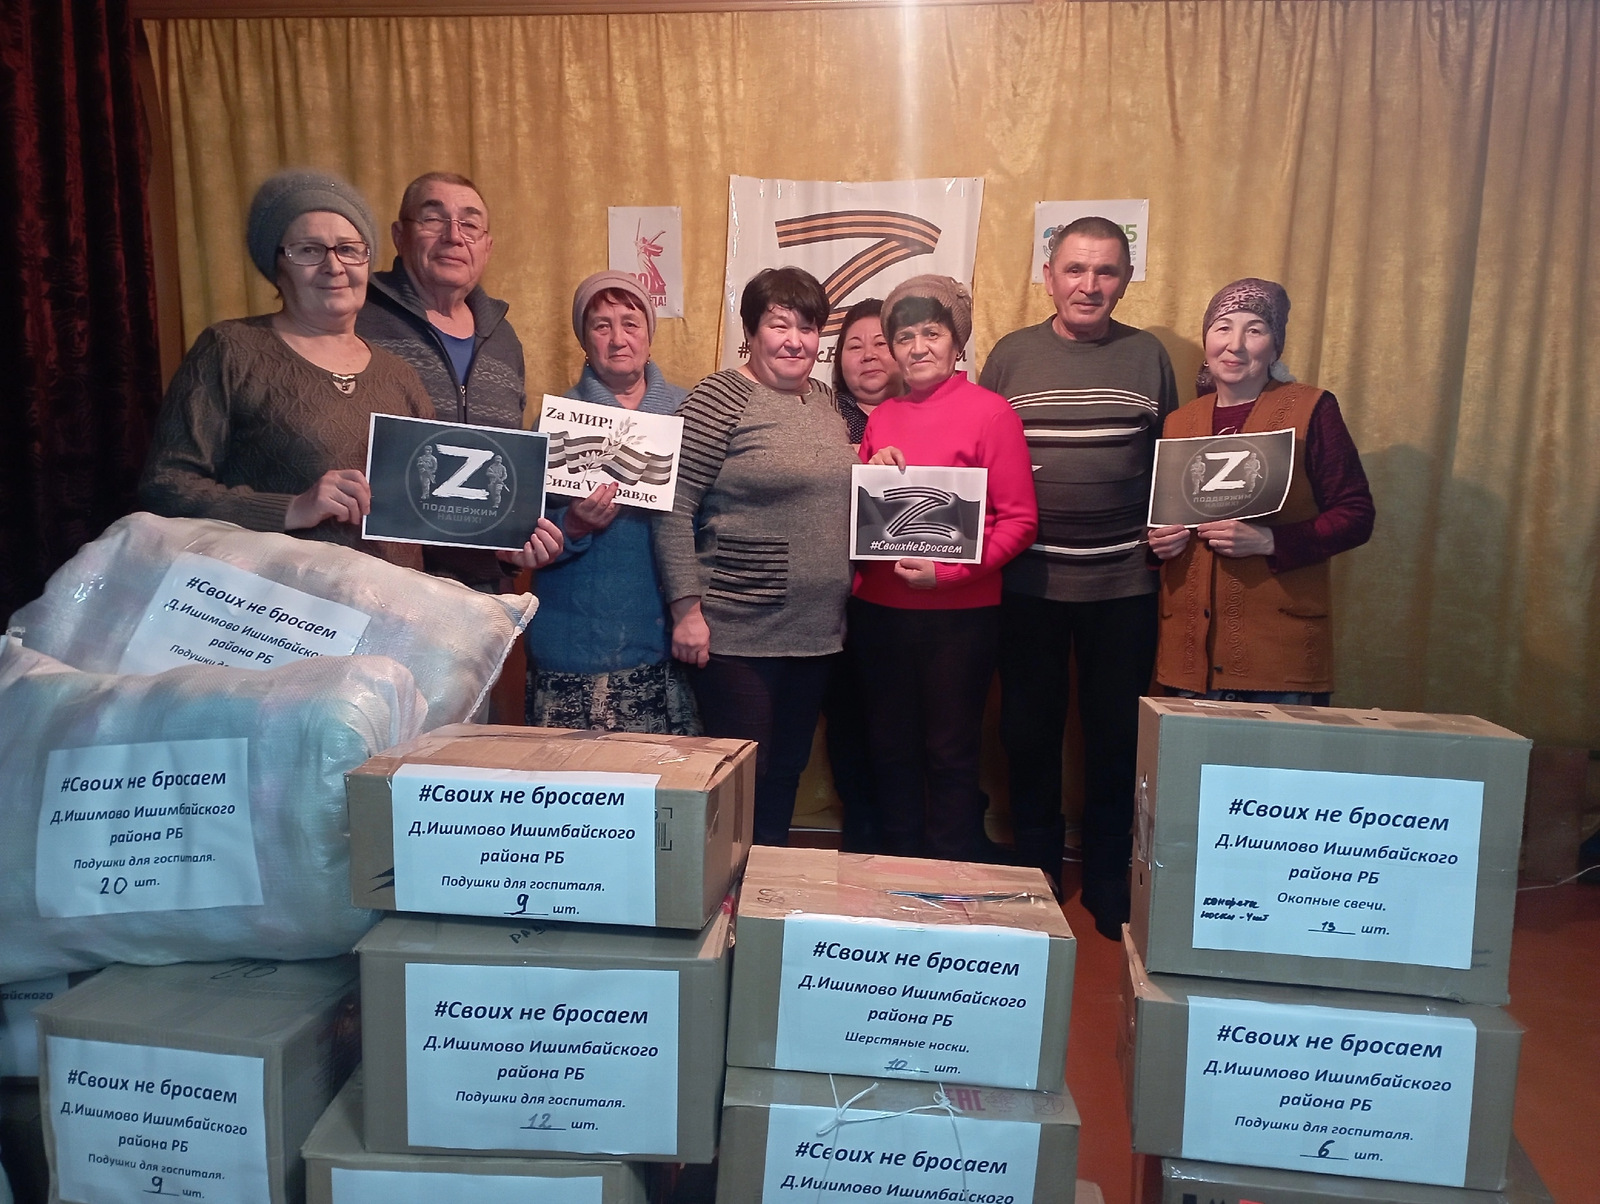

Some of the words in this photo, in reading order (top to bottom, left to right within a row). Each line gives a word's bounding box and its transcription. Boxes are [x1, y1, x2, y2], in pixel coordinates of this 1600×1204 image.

[569, 411, 614, 430] МИР!
[432, 443, 494, 501] Z
[1200, 451, 1250, 491] Z
[612, 488, 657, 503] равде
[1193, 494, 1251, 503] ПОДДЕРЖИМ
[422, 503, 497, 516] ПОДДЕРЖИМ
[438, 513, 481, 523] НАШИХ!
[870, 540, 962, 553] #СвоихНеБросаем
[186, 576, 246, 608] #Своих
[249, 602, 265, 616] не
[269, 607, 338, 640] бросаем
[164, 598, 240, 632] Д.Ишимово
[241, 627, 323, 657] Ишимбайско
[209, 637, 254, 658] района
[255, 652, 274, 665] РБ
[61, 776, 124, 793] #Своих
[127, 776, 146, 789] не
[152, 770, 226, 790] бросаем
[418, 784, 494, 803] #Своих
[500, 789, 525, 804] не
[531, 787, 625, 808] бросаем
[50, 809, 130, 825] Д.Ишимово
[134, 803, 236, 818] Ишимбайского
[1228, 798, 1310, 820] #Своих
[1315, 806, 1342, 822] не
[1348, 807, 1450, 830] бросаем
[110, 830, 161, 846] района
[166, 828, 183, 839] РБ
[408, 821, 506, 837] Д.Ишимово
[510, 823, 636, 840] Ишимбайского
[480, 849, 539, 864] района
[545, 851, 564, 863] РБ
[1215, 834, 1318, 854] Д.Ишимово
[1323, 842, 1458, 865] Ишимбайского
[73, 859, 125, 871] Подушки
[128, 856, 150, 867] для
[153, 854, 216, 864] госпиталя.
[100, 877, 127, 895] 20
[134, 878, 160, 888] шт.
[441, 875, 500, 890] Подушки
[504, 877, 526, 889] для
[530, 880, 605, 892] госпиталя.
[1288, 866, 1352, 882] района
[1357, 870, 1380, 884] РБ
[511, 893, 529, 915] 9
[552, 905, 579, 915] шт.
[1277, 892, 1340, 907] Окопные
[1344, 898, 1386, 911] свечи.
[1361, 926, 1389, 935] шт.
[812, 940, 890, 964] #Своих
[894, 951, 920, 967] не
[926, 952, 1020, 976] бросаем
[798, 974, 898, 996] Д.Ишимово
[901, 985, 1026, 1009] Ишимбайского
[434, 1000, 514, 1020] #Своих
[519, 1006, 545, 1021] не
[552, 1004, 648, 1025] бросаем
[867, 1008, 928, 1024] района
[932, 1013, 954, 1026] РБ
[423, 1036, 524, 1053] Д.Ишимово
[529, 1040, 659, 1057] Ишимбайского
[845, 1031, 926, 1050] Шерстяные
[928, 1040, 970, 1054] носки.
[1217, 1025, 1300, 1047] #Своих
[1306, 1034, 1334, 1050] не
[1340, 1033, 1443, 1058] бросаем
[497, 1066, 559, 1081] района
[564, 1067, 585, 1080] РБ
[934, 1065, 960, 1074] шт.
[1203, 1060, 1310, 1081] Д.Ишимово
[1314, 1069, 1452, 1092] Ишимбайского
[67, 1069, 129, 1092] #Своих
[135, 1079, 155, 1093] не
[160, 1078, 238, 1104] бросаем
[456, 1090, 517, 1105] Подушки
[520, 1093, 545, 1105] для
[548, 1096, 626, 1108] госпиталя.
[1279, 1093, 1344, 1110] района
[1350, 1098, 1373, 1112] РБ
[60, 1102, 139, 1123] Д.Ишимово
[142, 1112, 248, 1136] Ишимбайского
[528, 1113, 552, 1129] 12
[571, 1120, 599, 1131] шт.
[1235, 1115, 1299, 1132] Подушки
[1303, 1121, 1327, 1134] для
[1332, 1127, 1414, 1141] госпиталя.
[118, 1134, 168, 1151] района
[172, 1139, 189, 1152] РБ
[1317, 1139, 1335, 1158] 6
[1354, 1151, 1384, 1162] шт.
[88, 1153, 136, 1170] Подушки
[139, 1160, 158, 1172] для
[161, 1165, 225, 1180] госпиталя.
[795, 1141, 875, 1164] #Своих
[879, 1152, 906, 1166] не
[912, 1150, 1008, 1174] бросаем
[151, 1175, 163, 1193] 9
[182, 1188, 205, 1199] шт.
[780, 1174, 883, 1195] Д.Ишимово
[886, 1183, 1014, 1204] Ишимбайского
